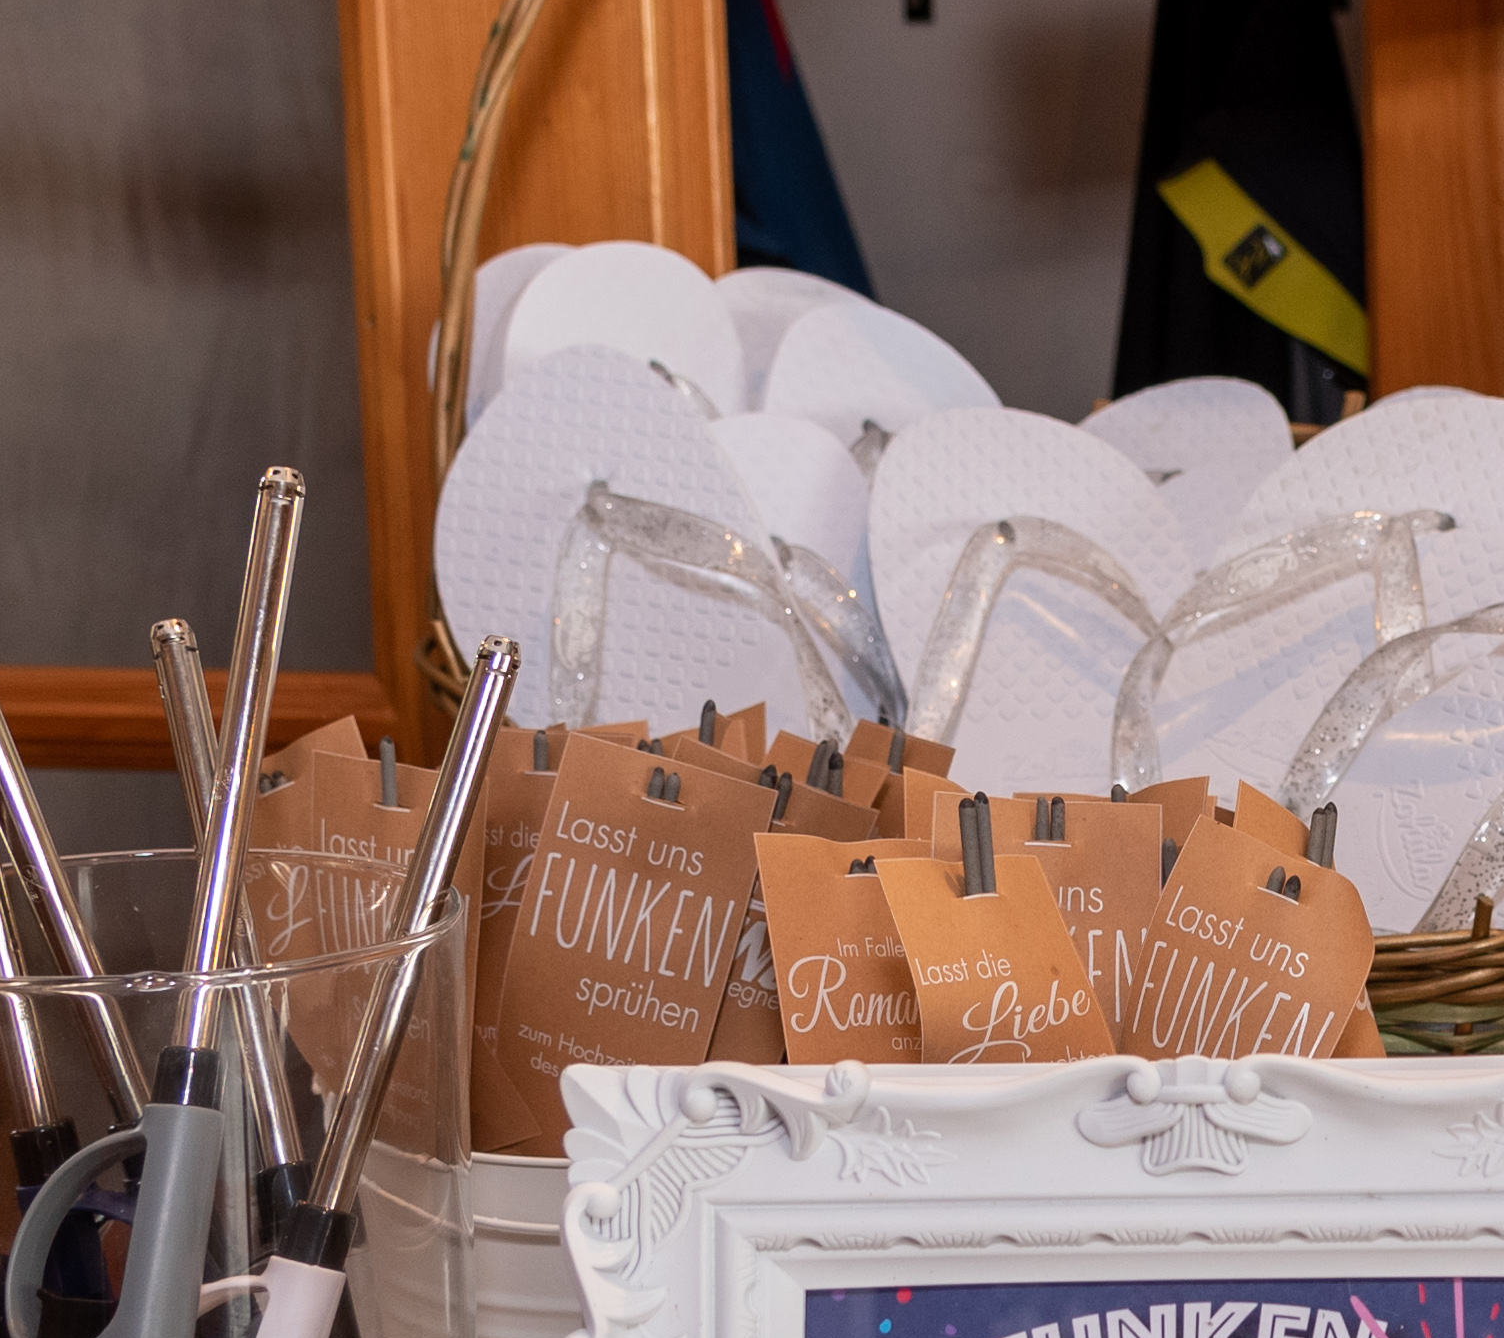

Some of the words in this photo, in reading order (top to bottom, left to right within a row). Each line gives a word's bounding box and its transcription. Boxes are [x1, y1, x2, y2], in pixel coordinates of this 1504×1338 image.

[511, 821, 540, 849] die
[556, 800, 638, 856] Lasst
[648, 840, 704, 875] uns
[530, 851, 735, 988] FUNKEN
[837, 938, 858, 957] Im
[865, 936, 905, 958] Falle
[1165, 885, 1244, 949] Lasst
[1249, 933, 1309, 978] uns
[788, 954, 920, 1034] Roma
[915, 957, 970, 986] Lasst
[976, 949, 1012, 979] die
[1133, 941, 1334, 1059] FUNKEN
[518, 1024, 552, 1047] zum
[576, 976, 700, 1033] sprühen
[947, 980, 1091, 1064] Liebe
[530, 1052, 559, 1078] des
